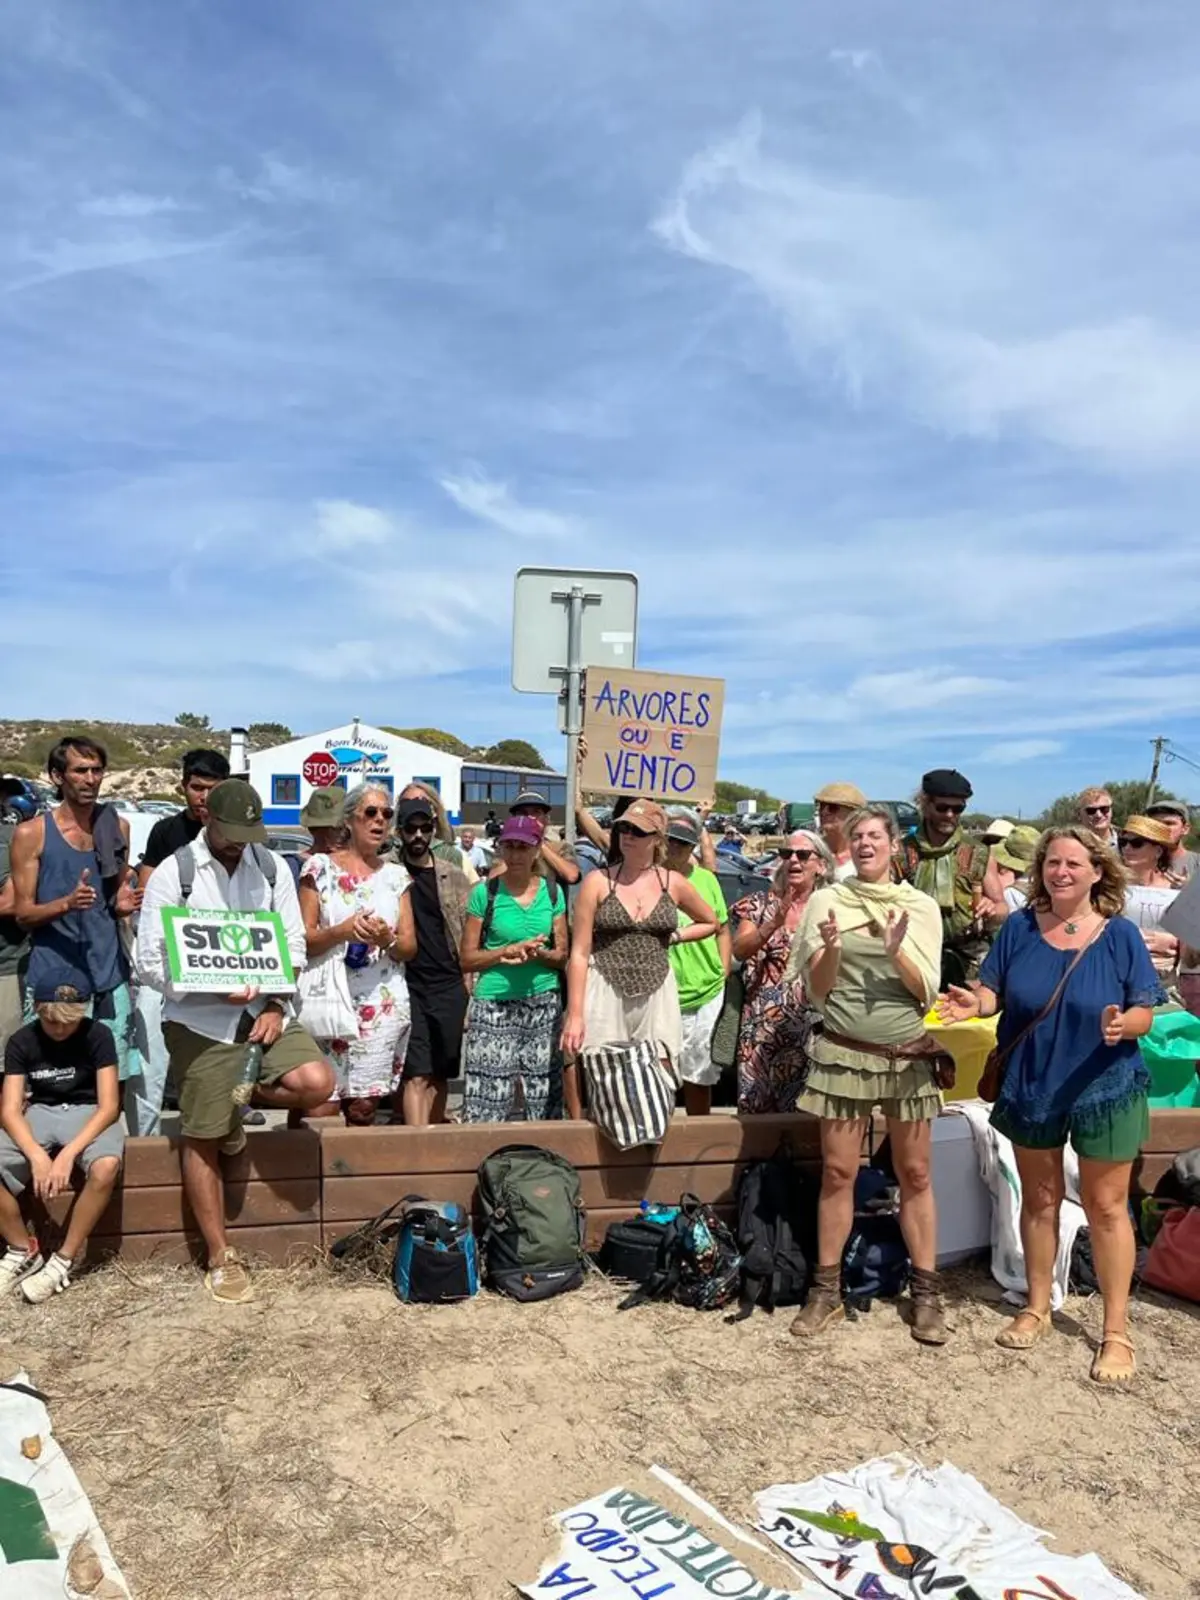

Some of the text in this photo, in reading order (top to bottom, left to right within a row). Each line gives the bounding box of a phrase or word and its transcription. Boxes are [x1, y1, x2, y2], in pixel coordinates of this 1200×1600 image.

[592, 681, 710, 727] ARVORES
[620, 727, 684, 750] OU E
[303, 762, 337, 777] STOP
[604, 750, 695, 792] VENTO
[182, 923, 273, 955] STOP
